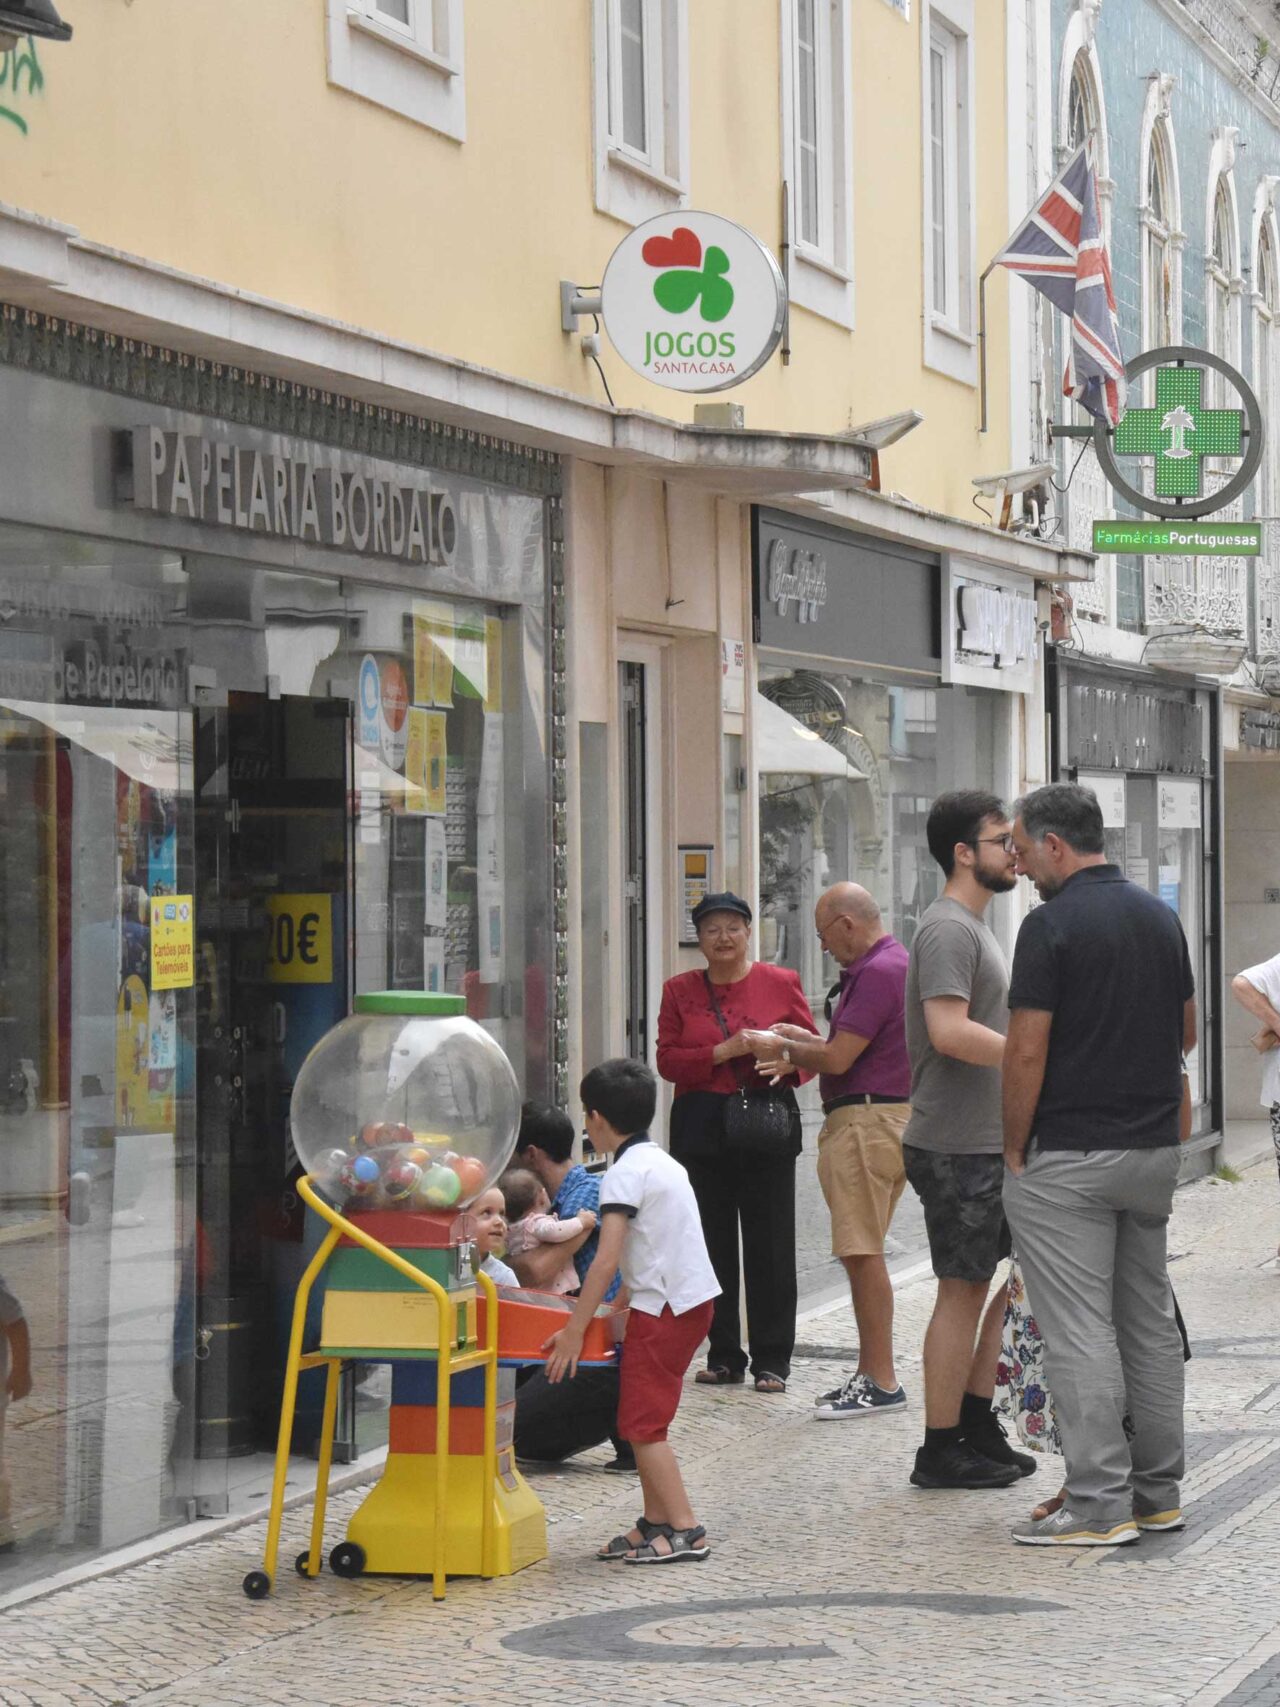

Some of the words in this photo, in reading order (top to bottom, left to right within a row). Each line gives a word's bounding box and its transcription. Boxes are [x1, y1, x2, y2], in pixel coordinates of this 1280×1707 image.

[643, 331, 736, 367] JOGOS
[150, 426, 321, 542] PAPELARIA
[331, 467, 460, 567] BORDALO
